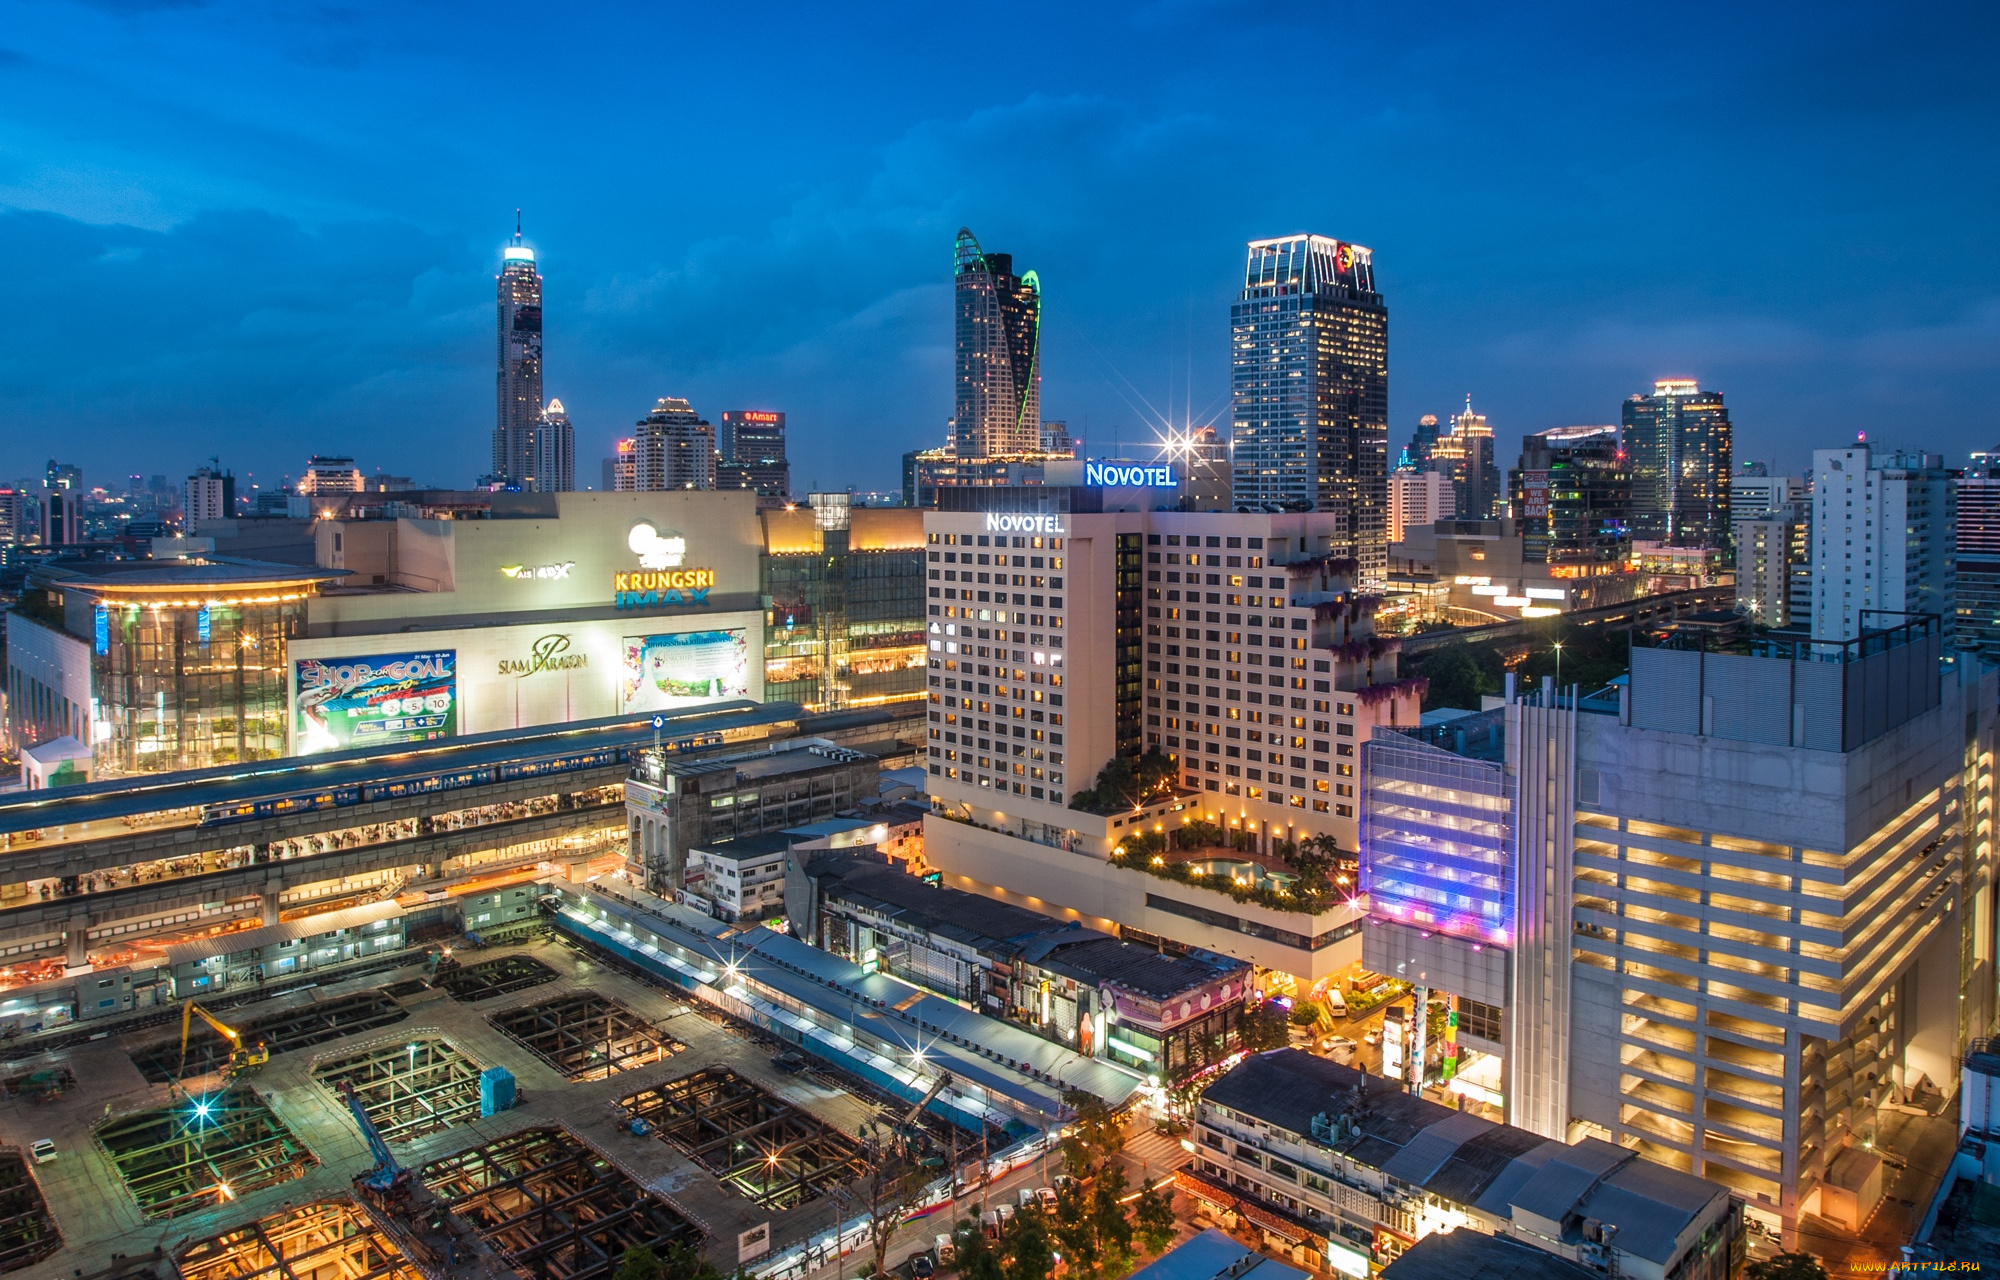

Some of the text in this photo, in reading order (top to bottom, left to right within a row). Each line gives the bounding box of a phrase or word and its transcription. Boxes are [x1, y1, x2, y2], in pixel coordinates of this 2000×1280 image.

[1087, 463, 1177, 487] NOVOTEL
[1525, 474, 1548, 483] ZEN
[1524, 505, 1548, 516] BACK
[986, 513, 1065, 533] NOVOTEL
[517, 570, 532, 579] AIS
[615, 569, 715, 591] KRUNGSRI
[615, 588, 711, 611] IMAX
[301, 664, 372, 688] SHOP
[388, 658, 450, 680] GOAL
[498, 653, 589, 675] SIAM PARAGON
